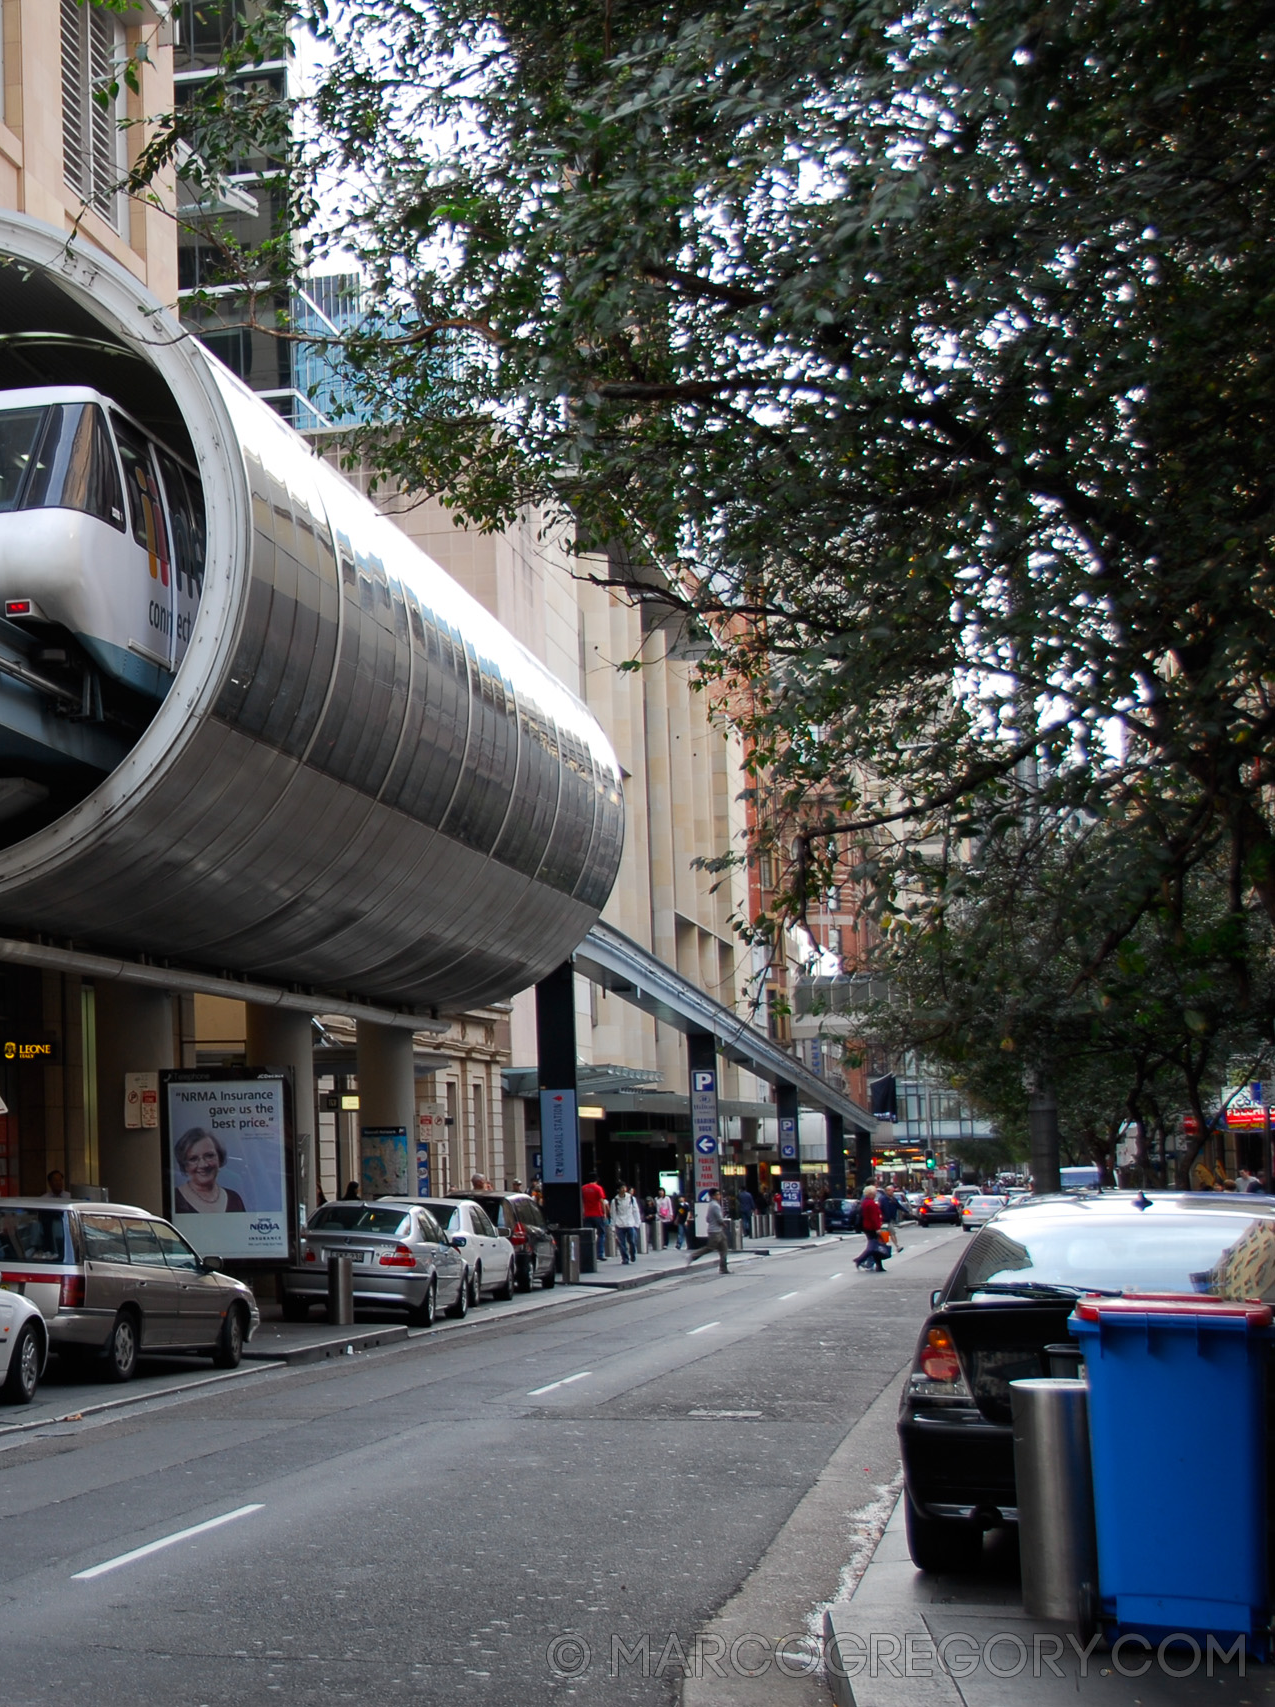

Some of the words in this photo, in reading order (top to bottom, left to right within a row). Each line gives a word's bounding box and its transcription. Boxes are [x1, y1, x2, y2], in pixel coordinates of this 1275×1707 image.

[19, 1045, 51, 1054] LEONE
[174, 1071, 210, 1081] Telephone
[695, 1073, 712, 1091] P
[220, 1089, 274, 1101] Insurance
[209, 1106, 236, 1118] gave
[239, 1105, 252, 1115] us
[255, 1103, 274, 1114] the
[553, 1103, 563, 1131] STATION
[212, 1119, 236, 1129] best
[782, 1121, 792, 1131] P
[554, 1132, 564, 1167] MONORAIL
[249, 1223, 280, 1231] NRMA
